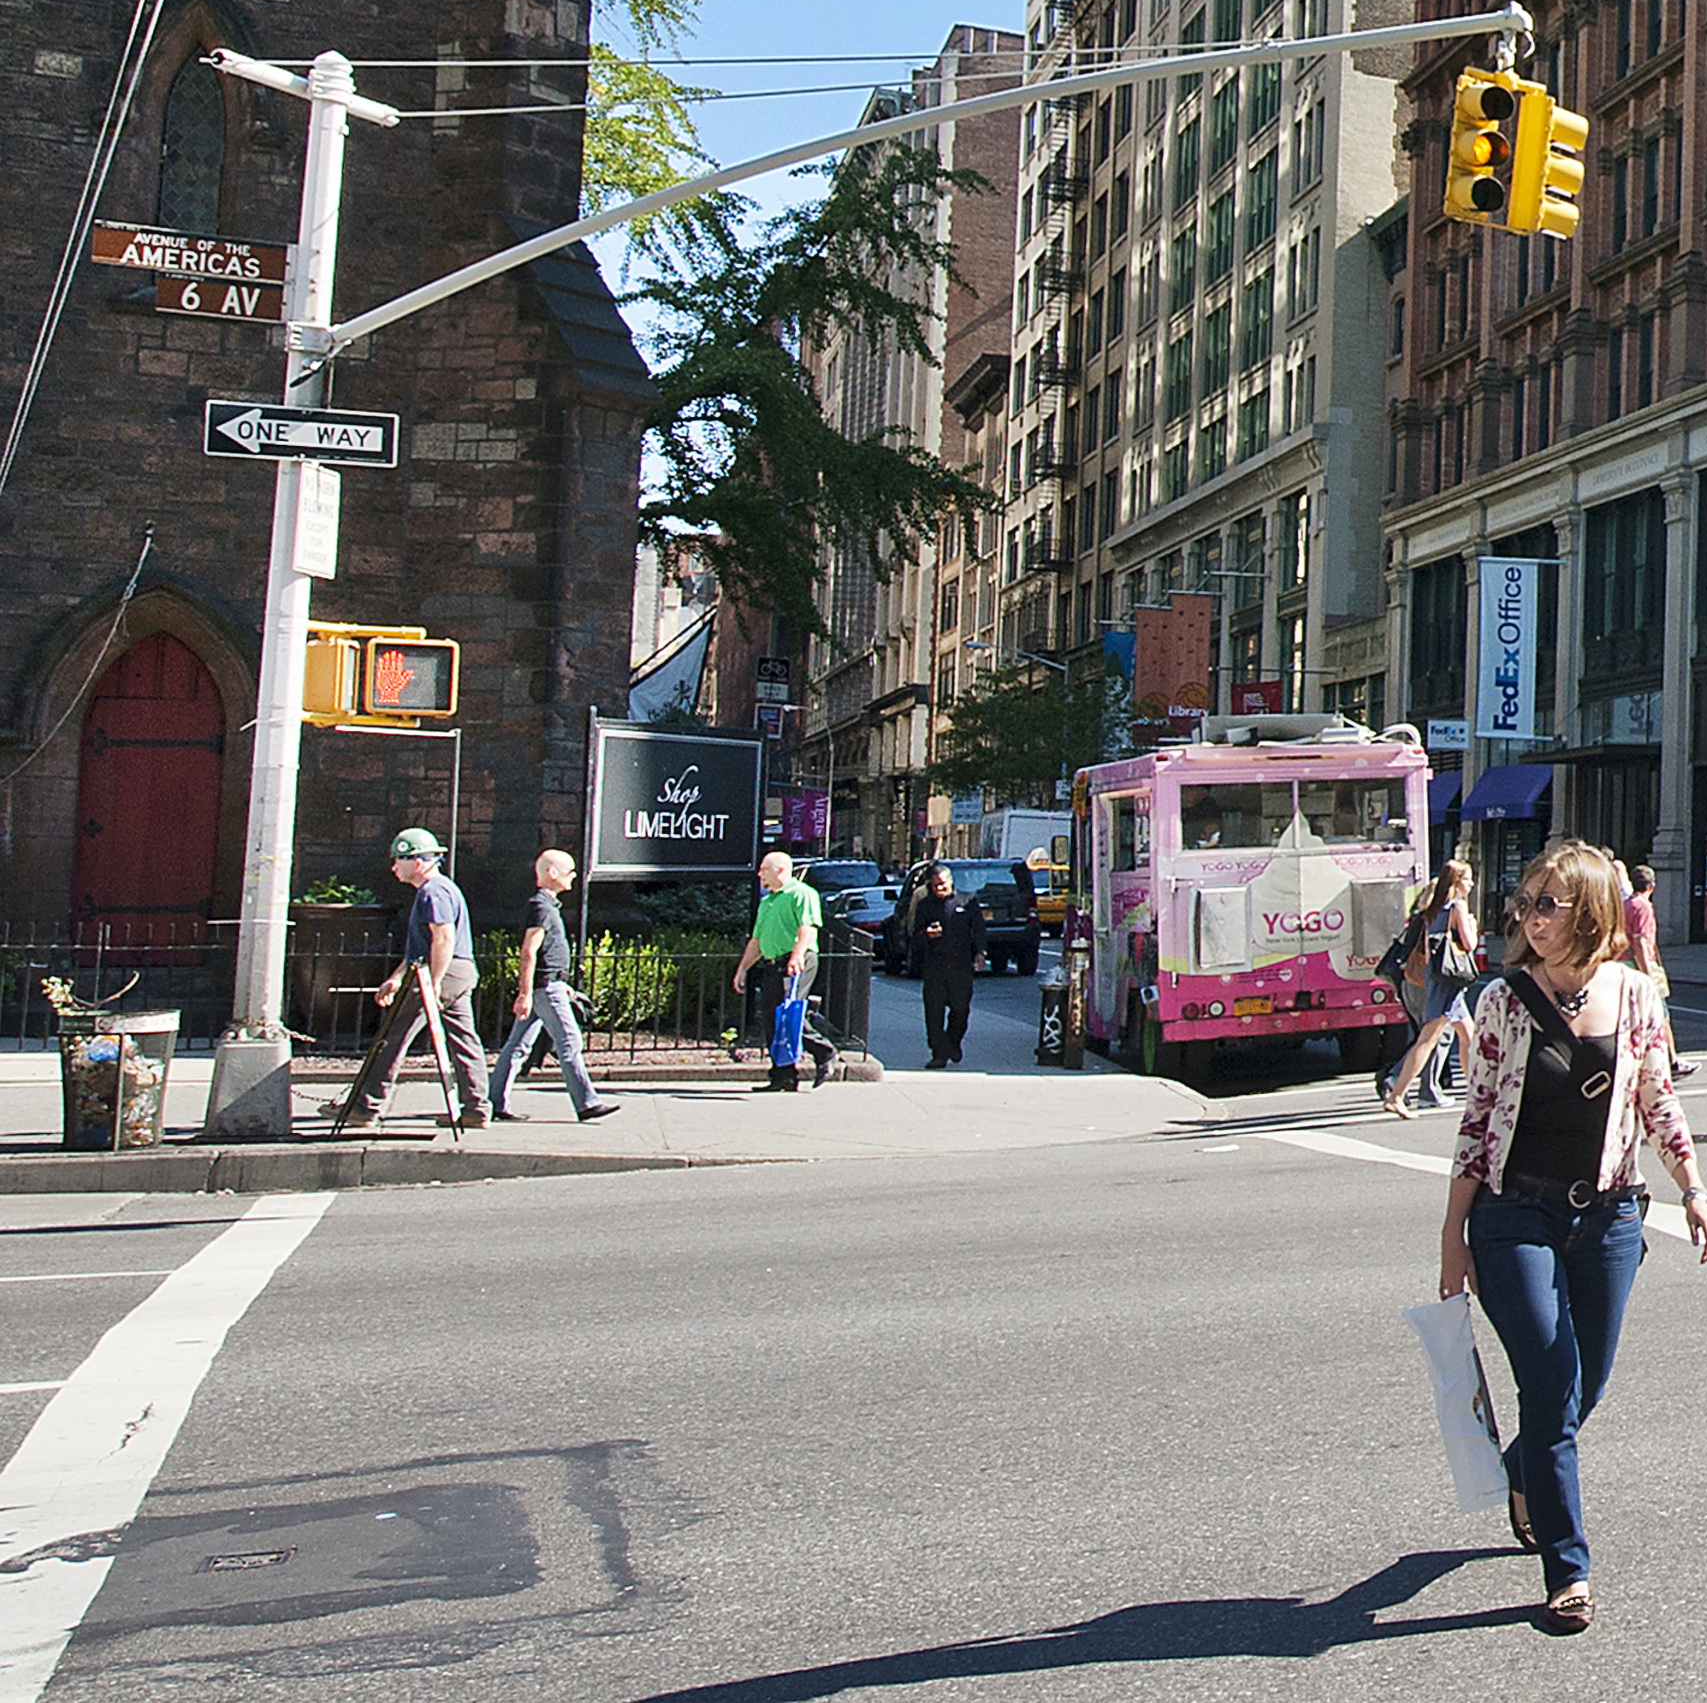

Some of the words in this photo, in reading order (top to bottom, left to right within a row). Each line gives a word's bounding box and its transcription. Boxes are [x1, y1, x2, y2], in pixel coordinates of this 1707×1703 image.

[133, 232, 188, 249] AVENUE
[197, 239, 216, 251] OF
[224, 242, 251, 257] THE
[119, 244, 261, 279] AMERICAS
[180, 282, 201, 310] 6
[220, 285, 261, 316] AV
[237, 420, 289, 442] ONE
[316, 426, 371, 448] WAY
[1498, 566, 1522, 645] Office
[1493, 647, 1519, 731] FedEx
[1168, 706, 1209, 717] Library
[657, 765, 701, 826] Shop
[624, 810, 730, 840] LIMELIGHT
[1201, 860, 1233, 871] YOGO
[1235, 860, 1268, 870] YOGO
[1262, 910, 1344, 934] YOGO
